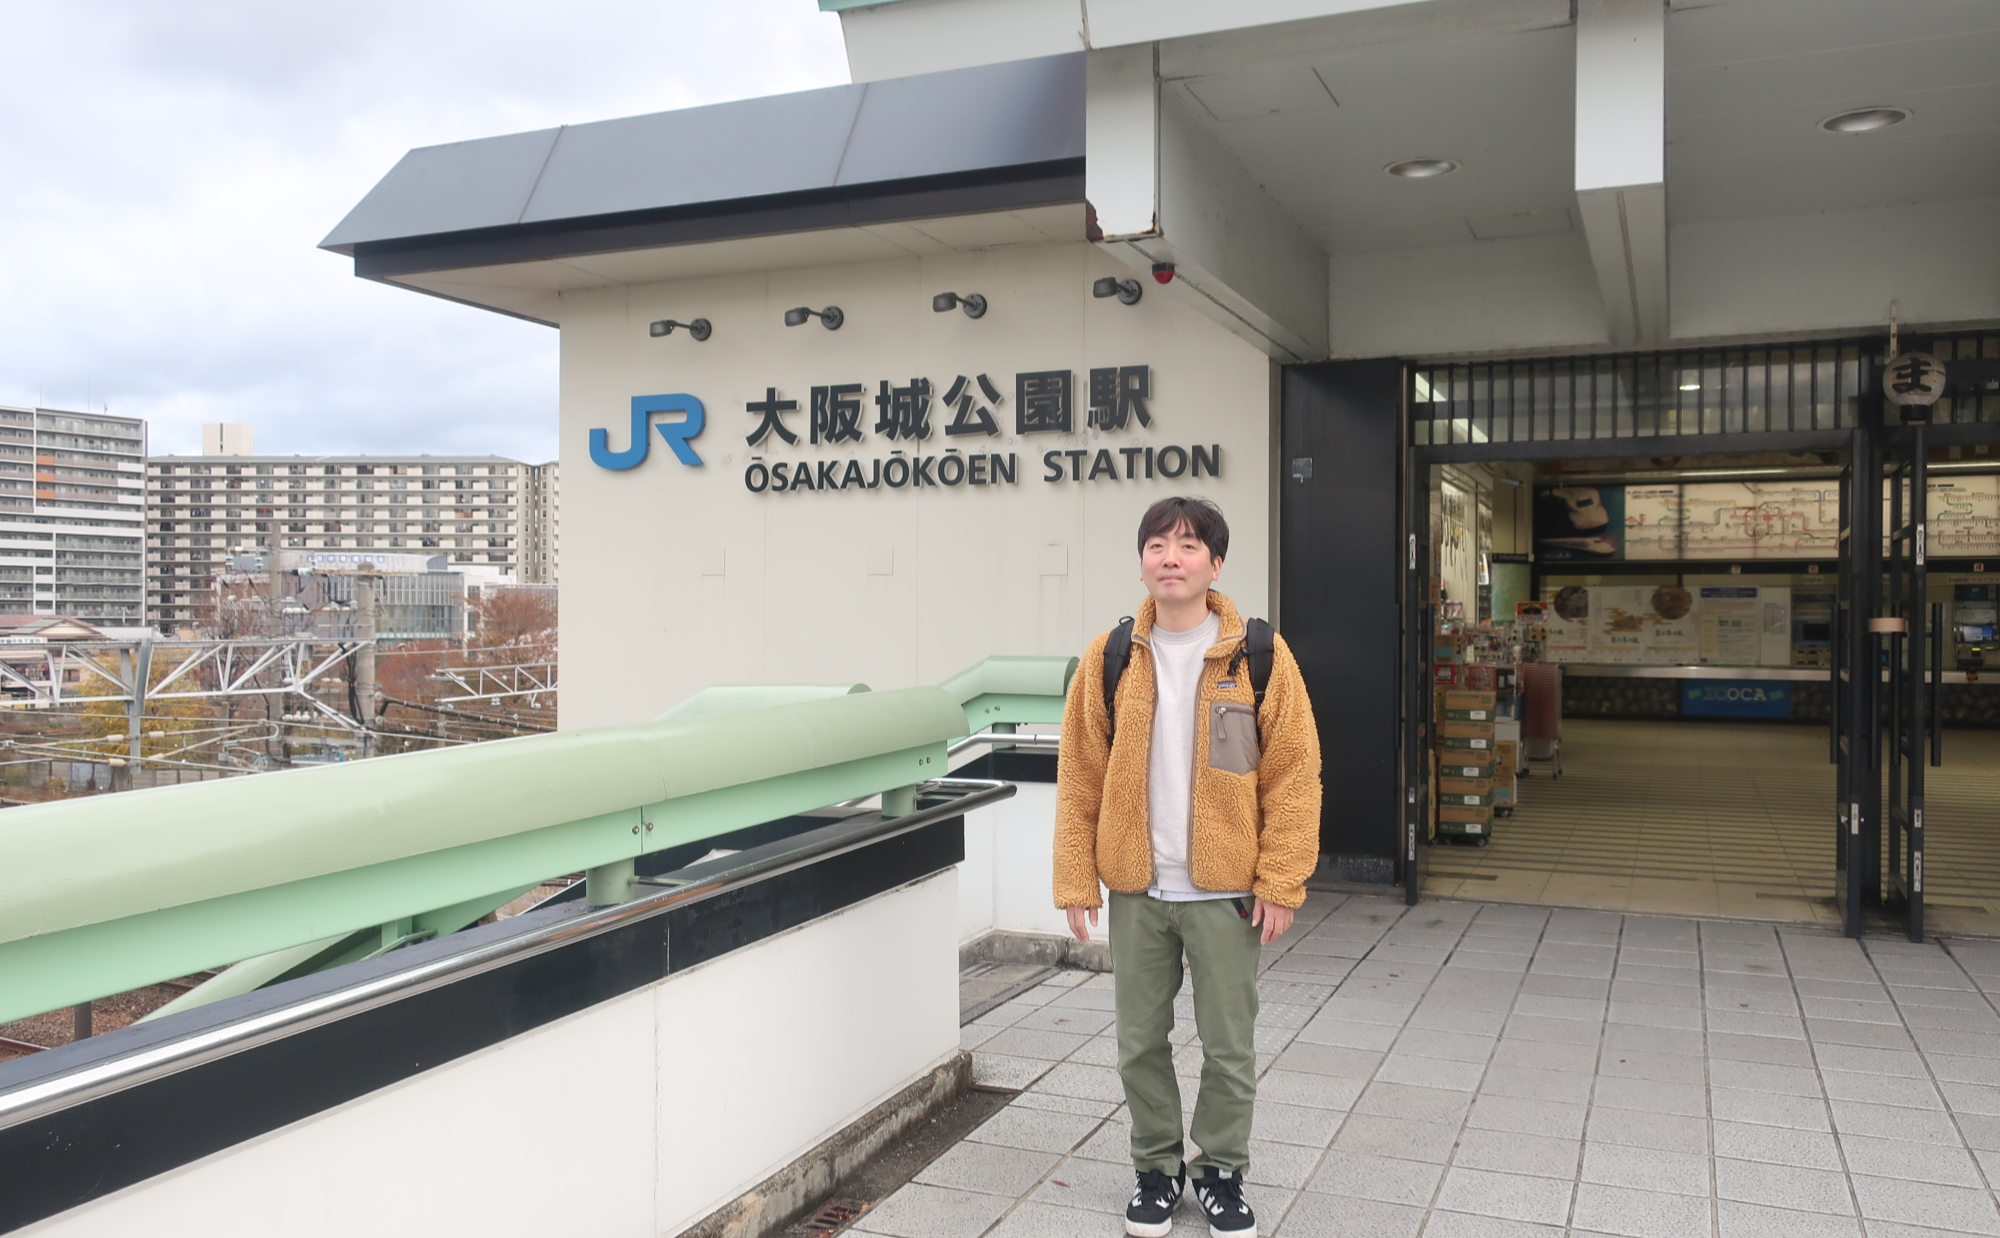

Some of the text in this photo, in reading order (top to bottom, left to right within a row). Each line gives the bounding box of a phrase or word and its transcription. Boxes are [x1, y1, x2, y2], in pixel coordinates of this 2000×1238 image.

[1891, 356, 1932, 394] ま
[745, 363, 1153, 448] 大阪城公園駅
[588, 392, 706, 470] JR
[744, 443, 1222, 493] ŌSAKAJŌKŌEN STATION
[1704, 686, 1768, 702] ICOCA
